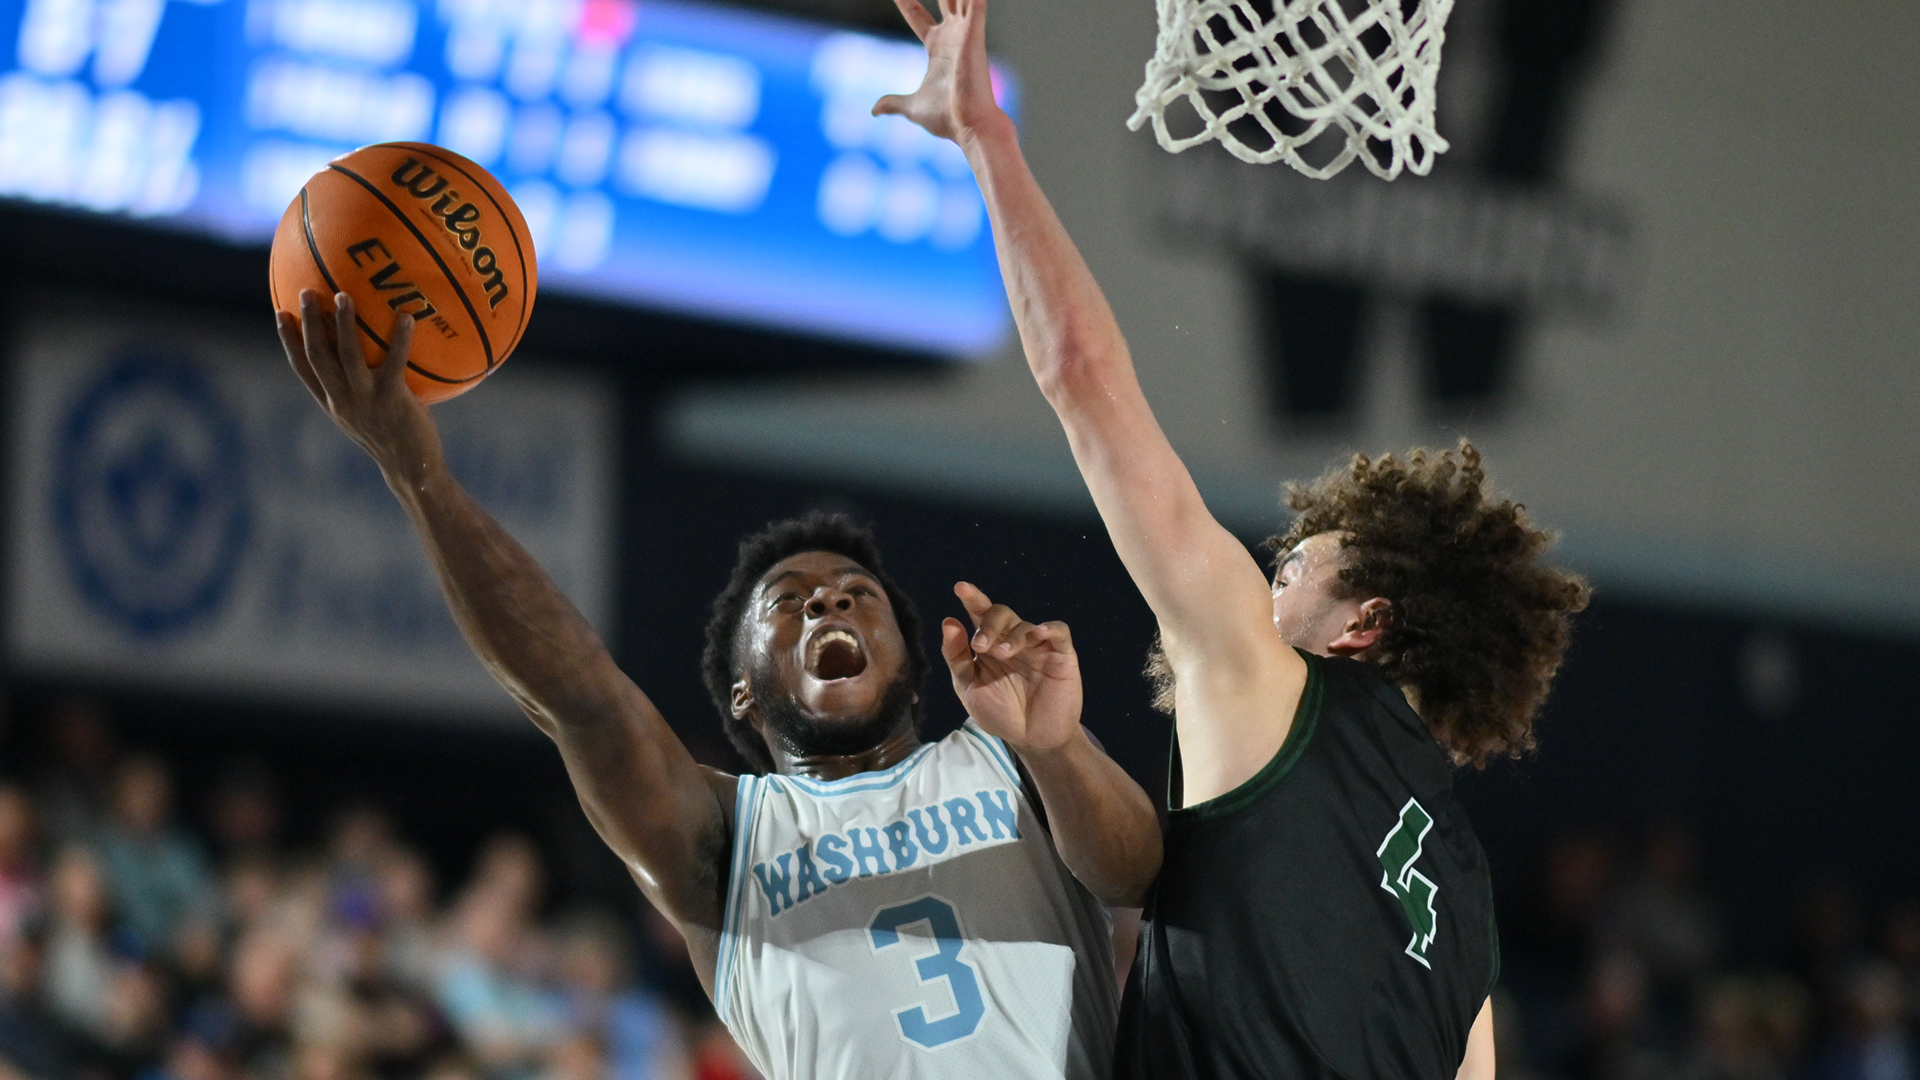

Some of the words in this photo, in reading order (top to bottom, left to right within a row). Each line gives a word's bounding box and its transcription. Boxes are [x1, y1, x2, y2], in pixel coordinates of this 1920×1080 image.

[391, 156, 509, 312] Wilson
[431, 316, 460, 339] NXT
[752, 788, 1022, 917] WASHBURN
[867, 893, 989, 1051] 3
